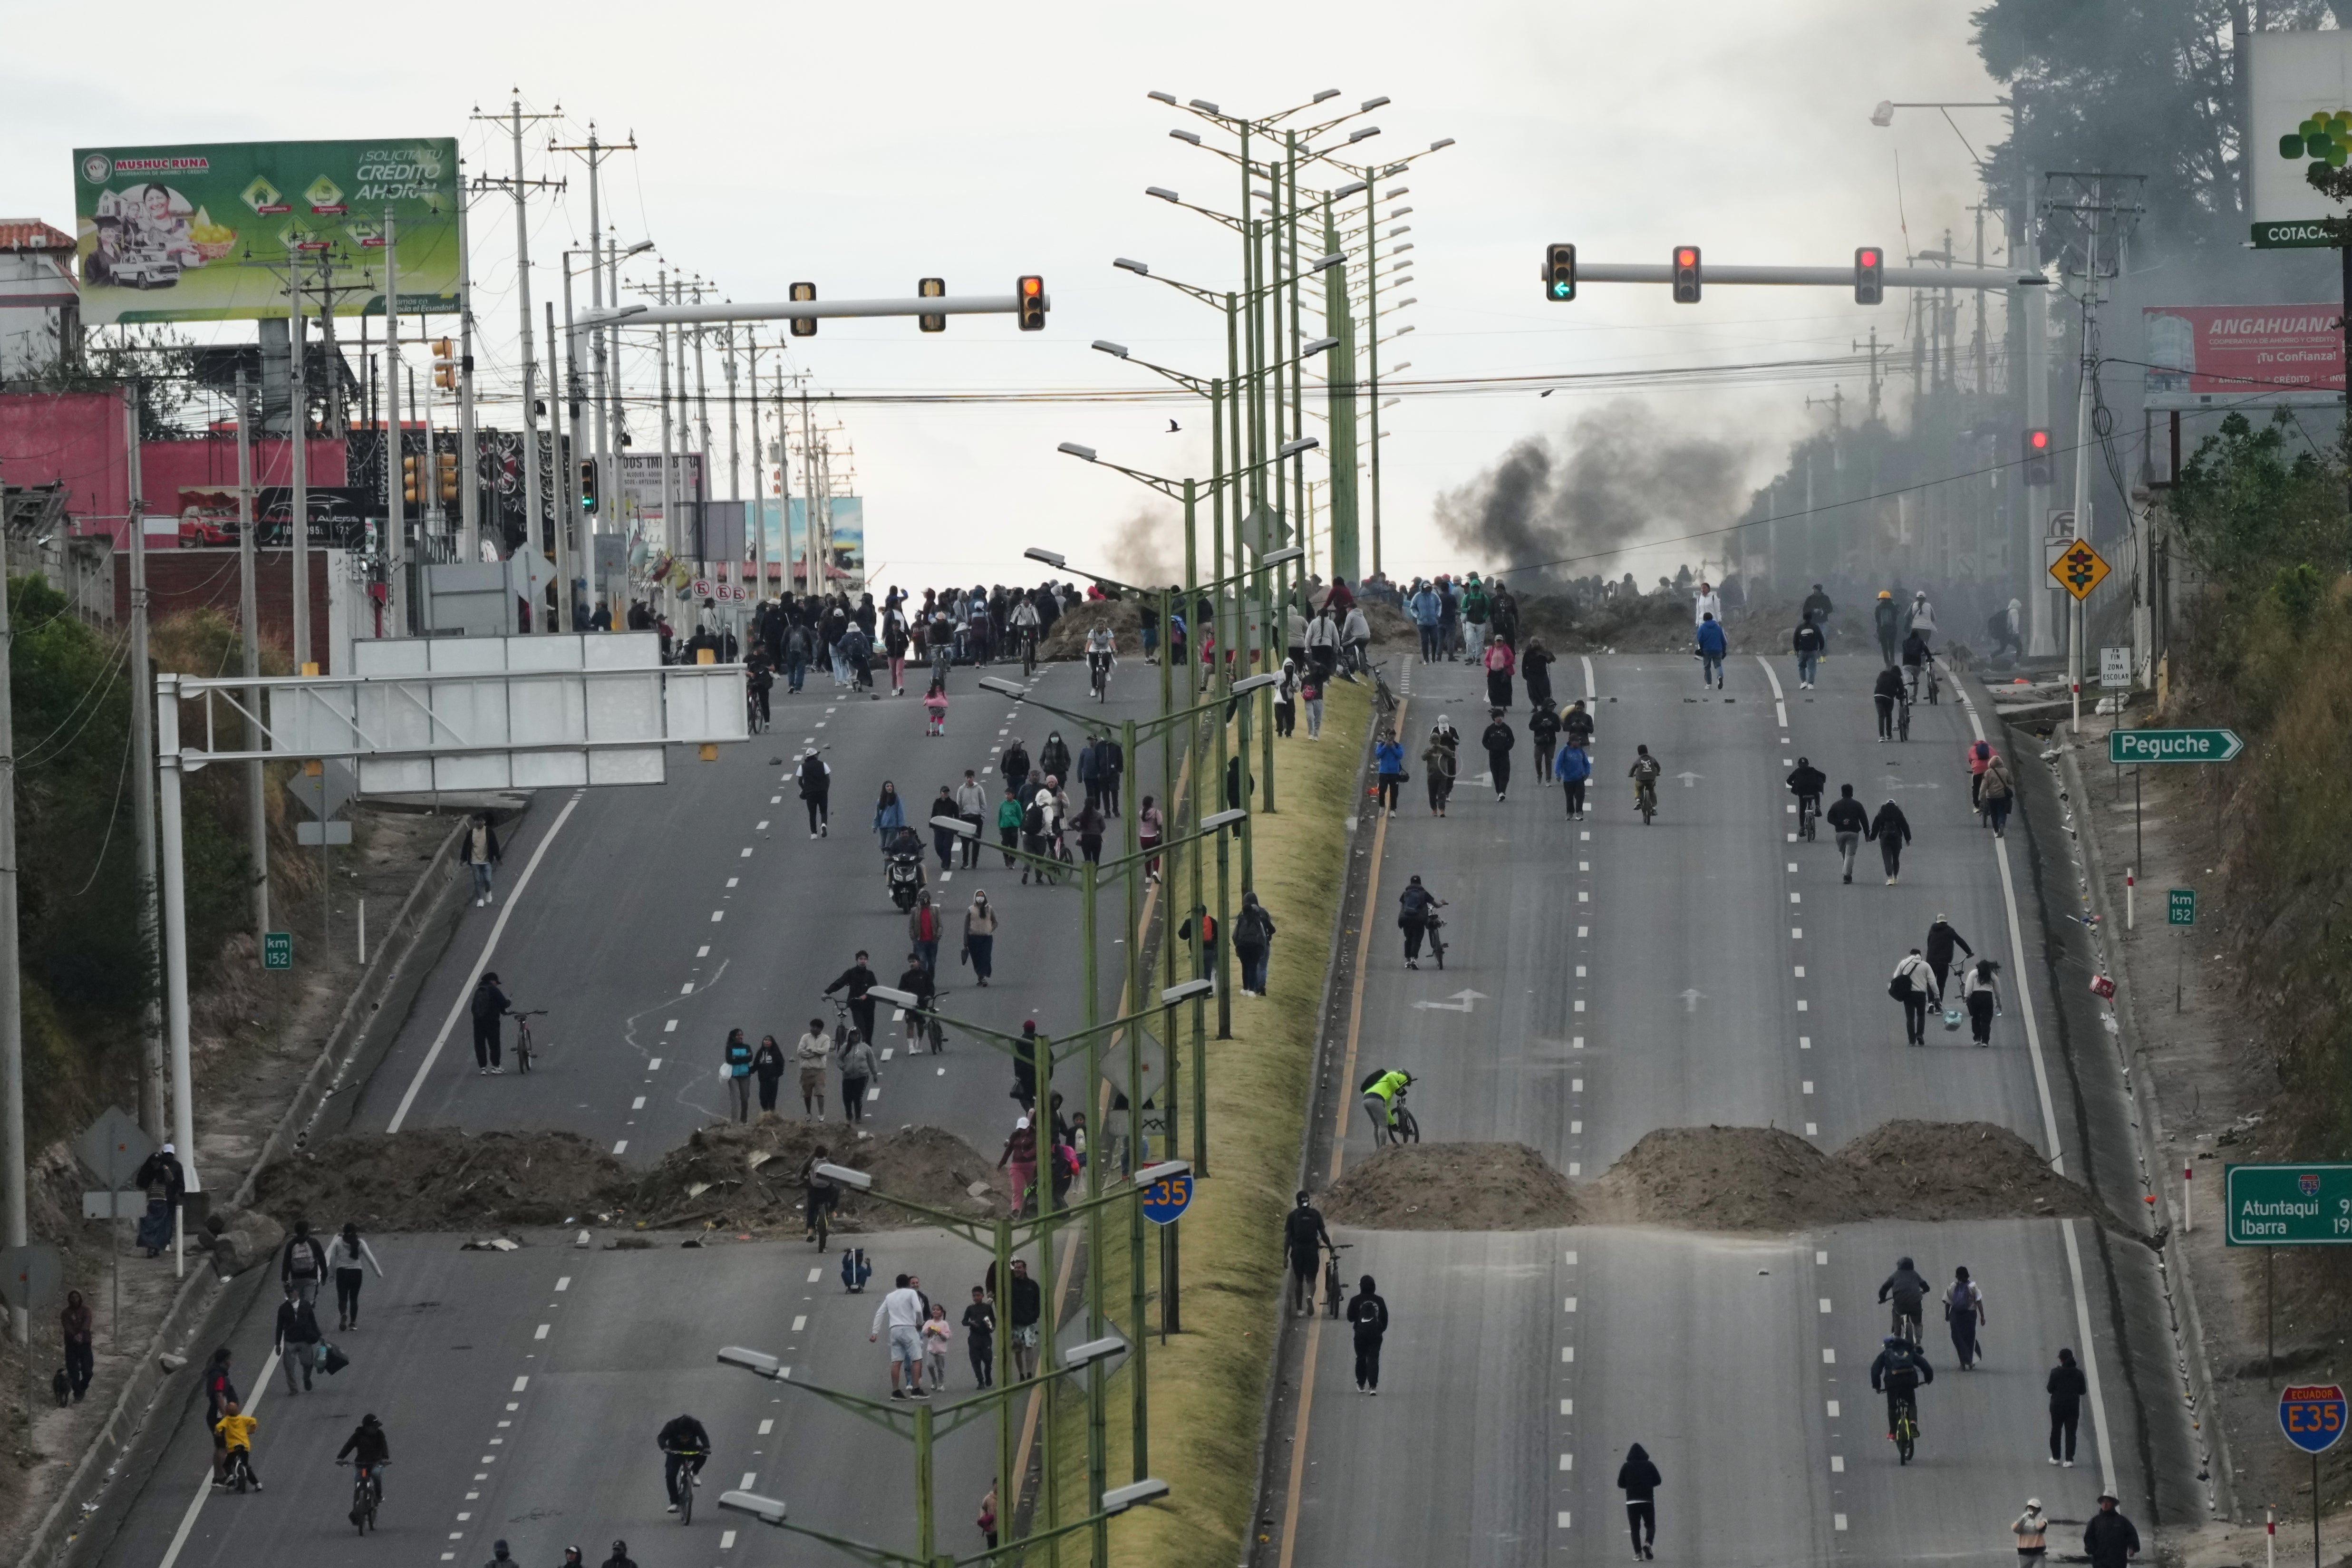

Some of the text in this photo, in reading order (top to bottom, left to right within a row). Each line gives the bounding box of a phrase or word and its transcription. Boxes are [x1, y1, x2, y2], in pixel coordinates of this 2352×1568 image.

[428, 150, 443, 160] TU
[116, 158, 208, 170] MUSHUC RUNA
[357, 162, 441, 181] CRÉDITO
[2209, 316, 2336, 334] ANGAHUANA
[2258, 350, 2336, 364] ¡Tu Confianza!
[2274, 374, 2310, 384] CRÉDITO
[2122, 735, 2210, 759] Peguche
[2172, 894, 2192, 905] km
[2172, 909, 2191, 921] 152
[267, 938, 288, 948] km
[268, 952, 288, 965] 152
[2242, 1199, 2319, 1219] Atuntaqui
[2241, 1219, 2286, 1235] Ibarra
[2292, 1389, 2333, 1400] ECUADOR
[2289, 1404, 2340, 1432] E35
